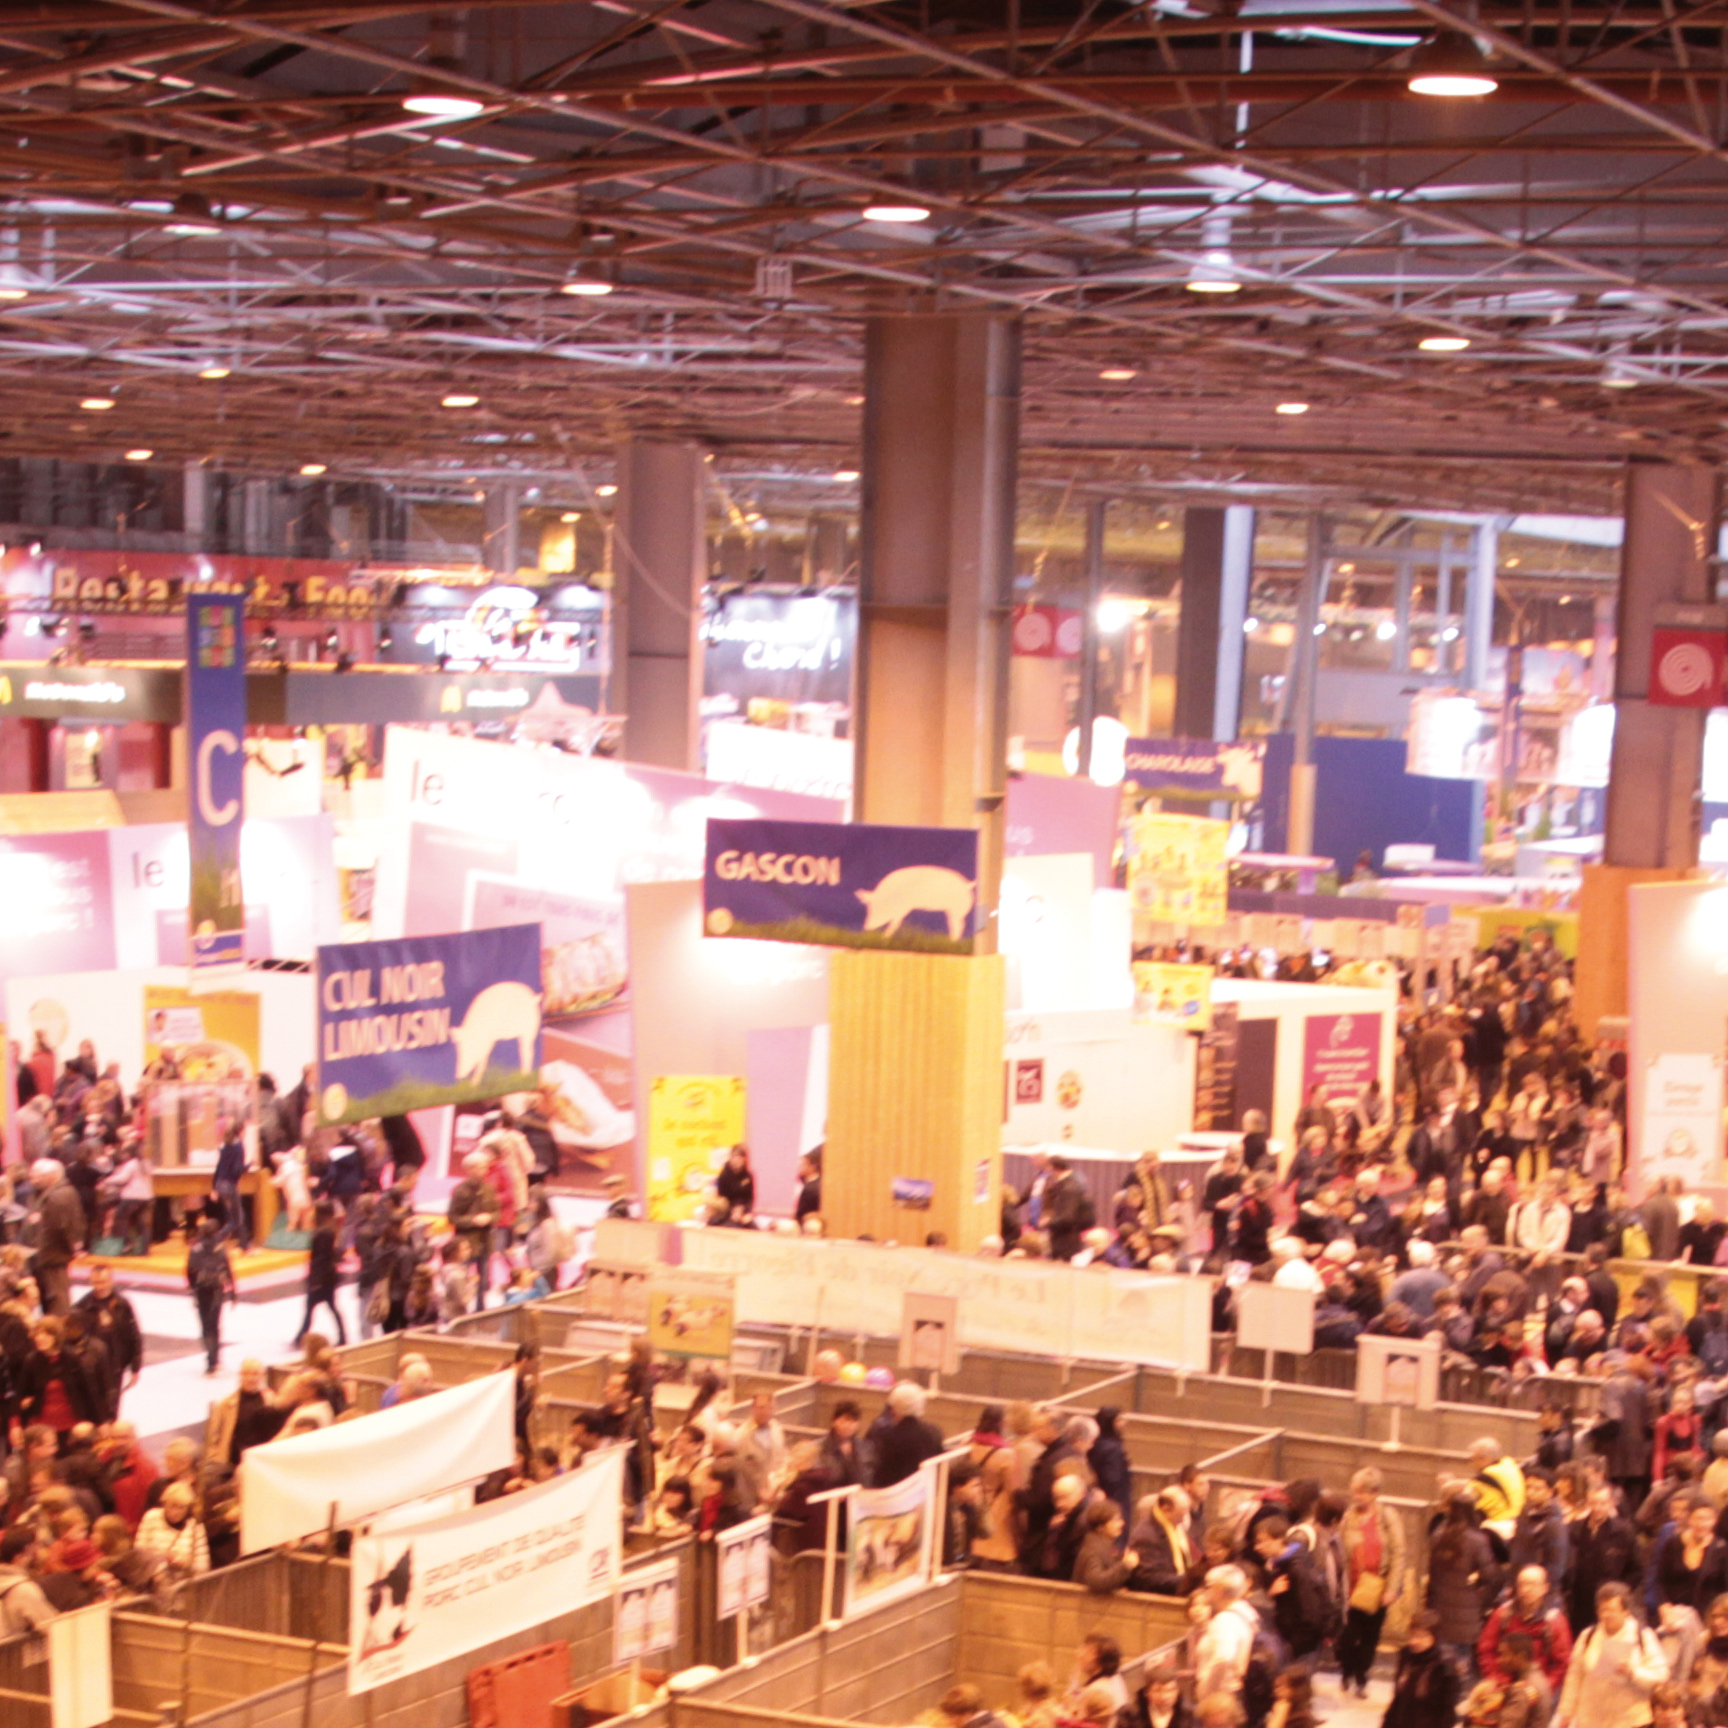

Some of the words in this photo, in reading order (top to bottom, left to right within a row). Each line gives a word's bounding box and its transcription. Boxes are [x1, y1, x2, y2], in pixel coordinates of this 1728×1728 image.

[196, 729, 240, 828] C
[714, 849, 842, 886] GASCON
[323, 965, 377, 1012] CUL
[380, 959, 446, 1004] NOIR
[323, 1008, 452, 1061] LIMOUSIN
